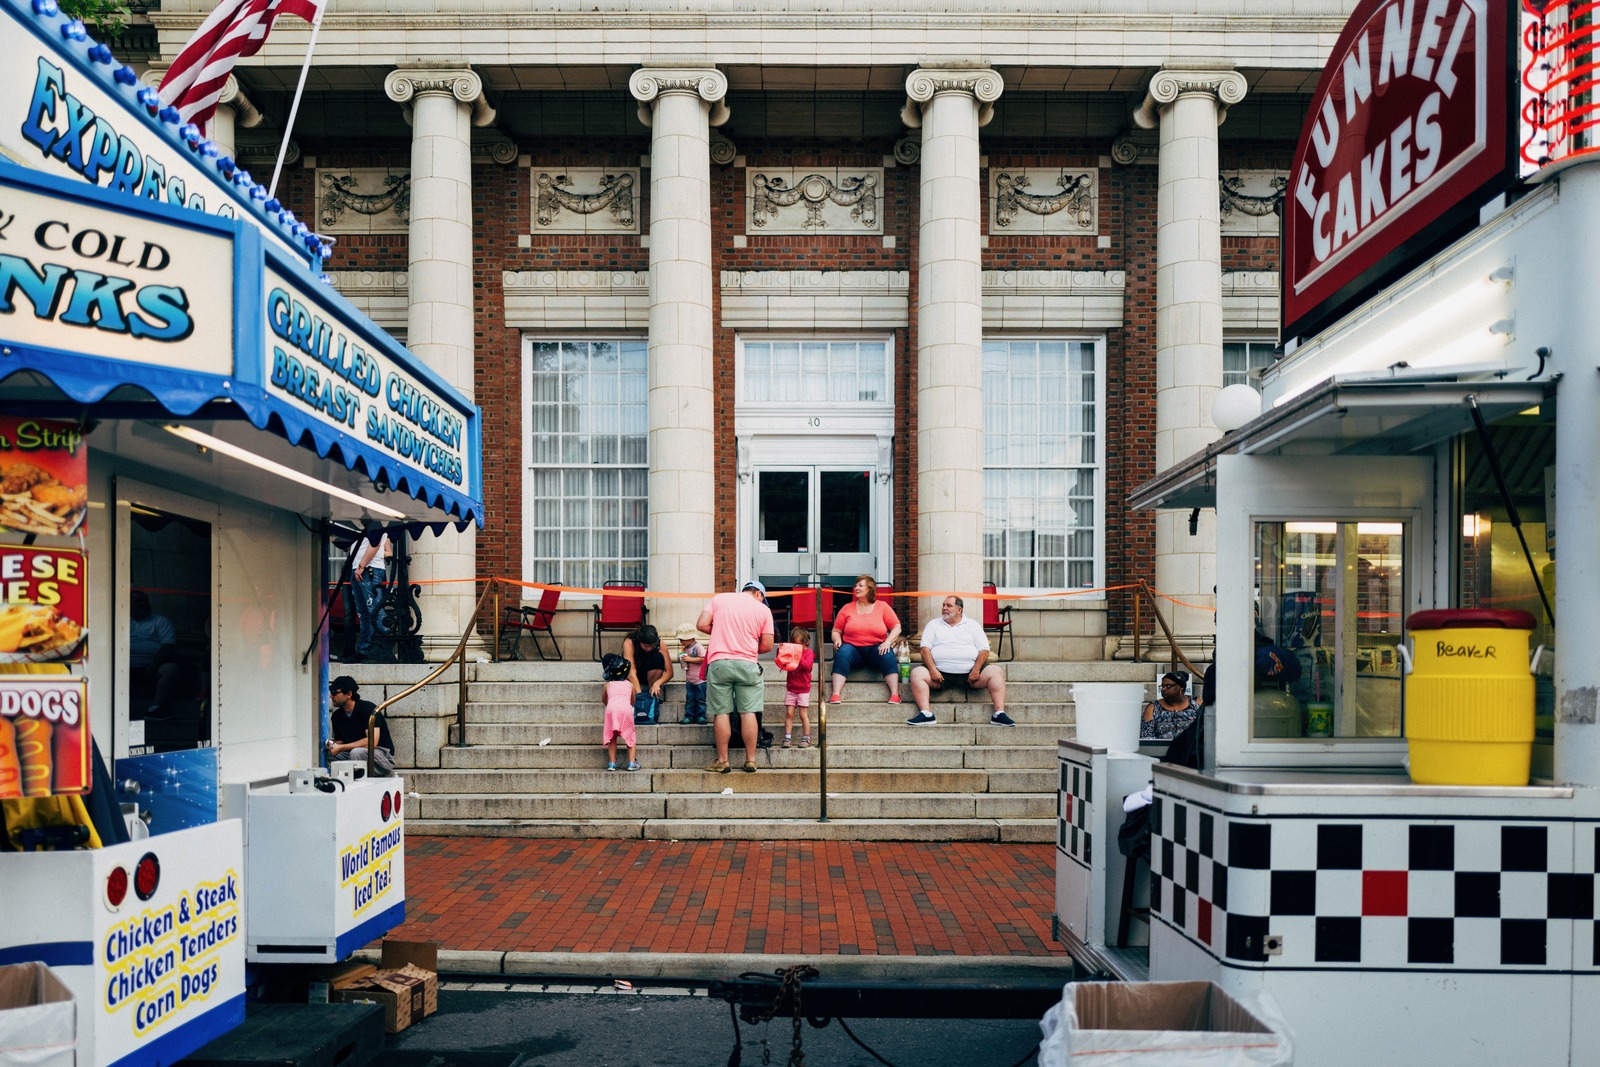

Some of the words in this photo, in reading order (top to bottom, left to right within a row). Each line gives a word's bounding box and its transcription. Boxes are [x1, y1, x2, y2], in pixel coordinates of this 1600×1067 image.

[1295, 0, 1472, 219] FUNNEL
[1312, 91, 1442, 263] CAKES
[34, 220, 171, 272] COLD
[267, 287, 381, 399] GRILLED
[386, 371, 462, 453] CHICKEN
[16, 421, 82, 454] Strip
[271, 345, 361, 430] BREAST
[366, 404, 463, 486] SANDWICHES
[808, 417, 821, 427] 40
[2, 554, 79, 585] ESE
[0, 689, 80, 727] DOGS
[342, 841, 369, 881] World
[371, 826, 401, 861] Famous
[354, 875, 373, 911] Iced
[375, 860, 392, 895] Tea!
[106, 911, 173, 963] Chicken
[178, 897, 191, 924] &
[195, 875, 237, 916] Steak
[108, 950, 175, 1006] Chicken
[180, 915, 237, 962] Tenders
[136, 989, 176, 1030] Corn
[181, 963, 218, 1002] Dogs
